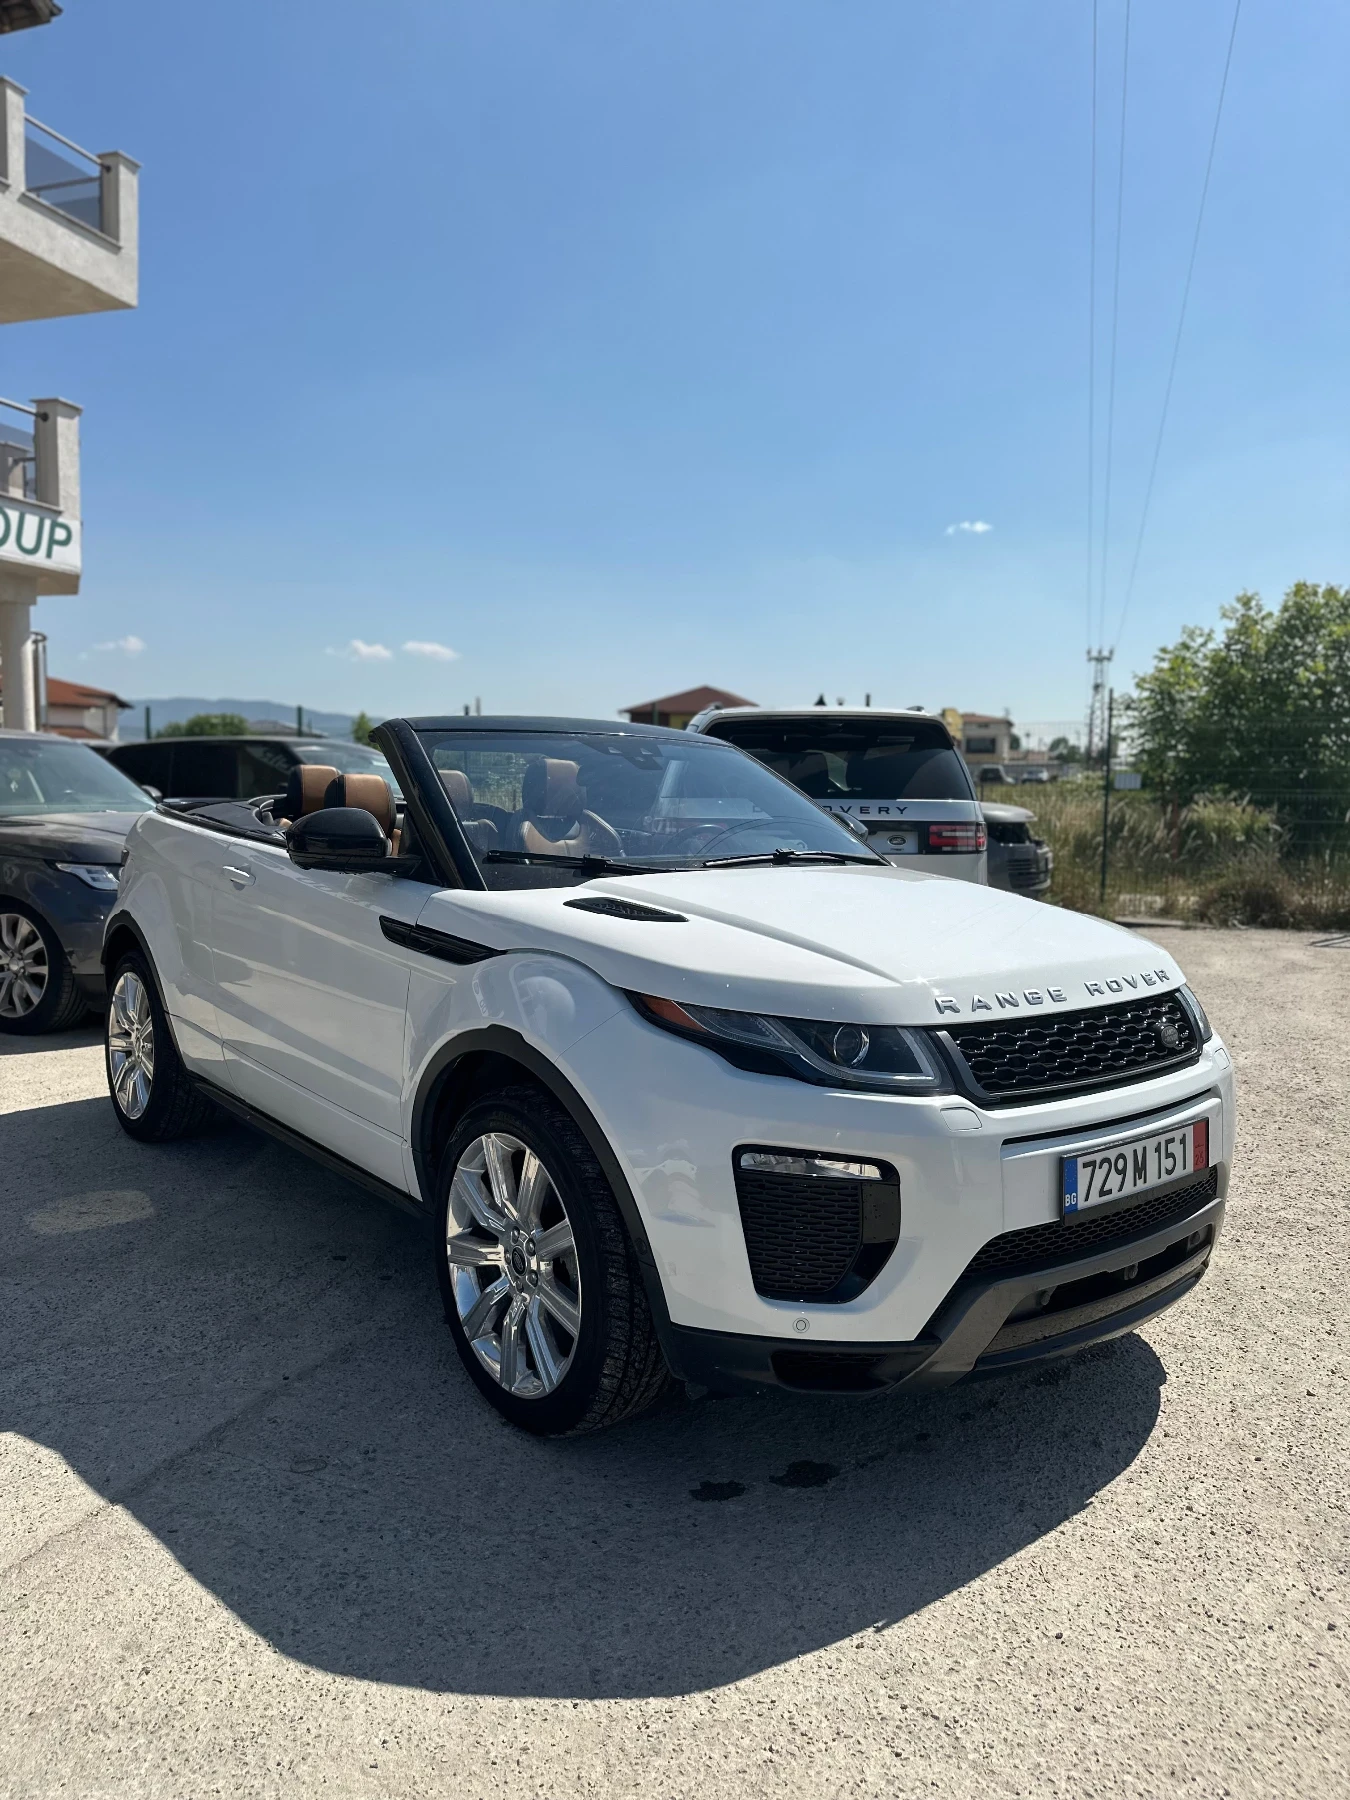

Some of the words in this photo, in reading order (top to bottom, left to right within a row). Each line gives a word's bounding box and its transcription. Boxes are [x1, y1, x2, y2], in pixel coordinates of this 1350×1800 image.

[934, 986, 1068, 1015] RANGE
[1084, 969, 1171, 997] ROVER
[1082, 1152, 1128, 1203] 729
[1132, 1145, 1147, 1188] M
[1154, 1133, 1187, 1180] 151
[1065, 1192, 1077, 1207] BG
